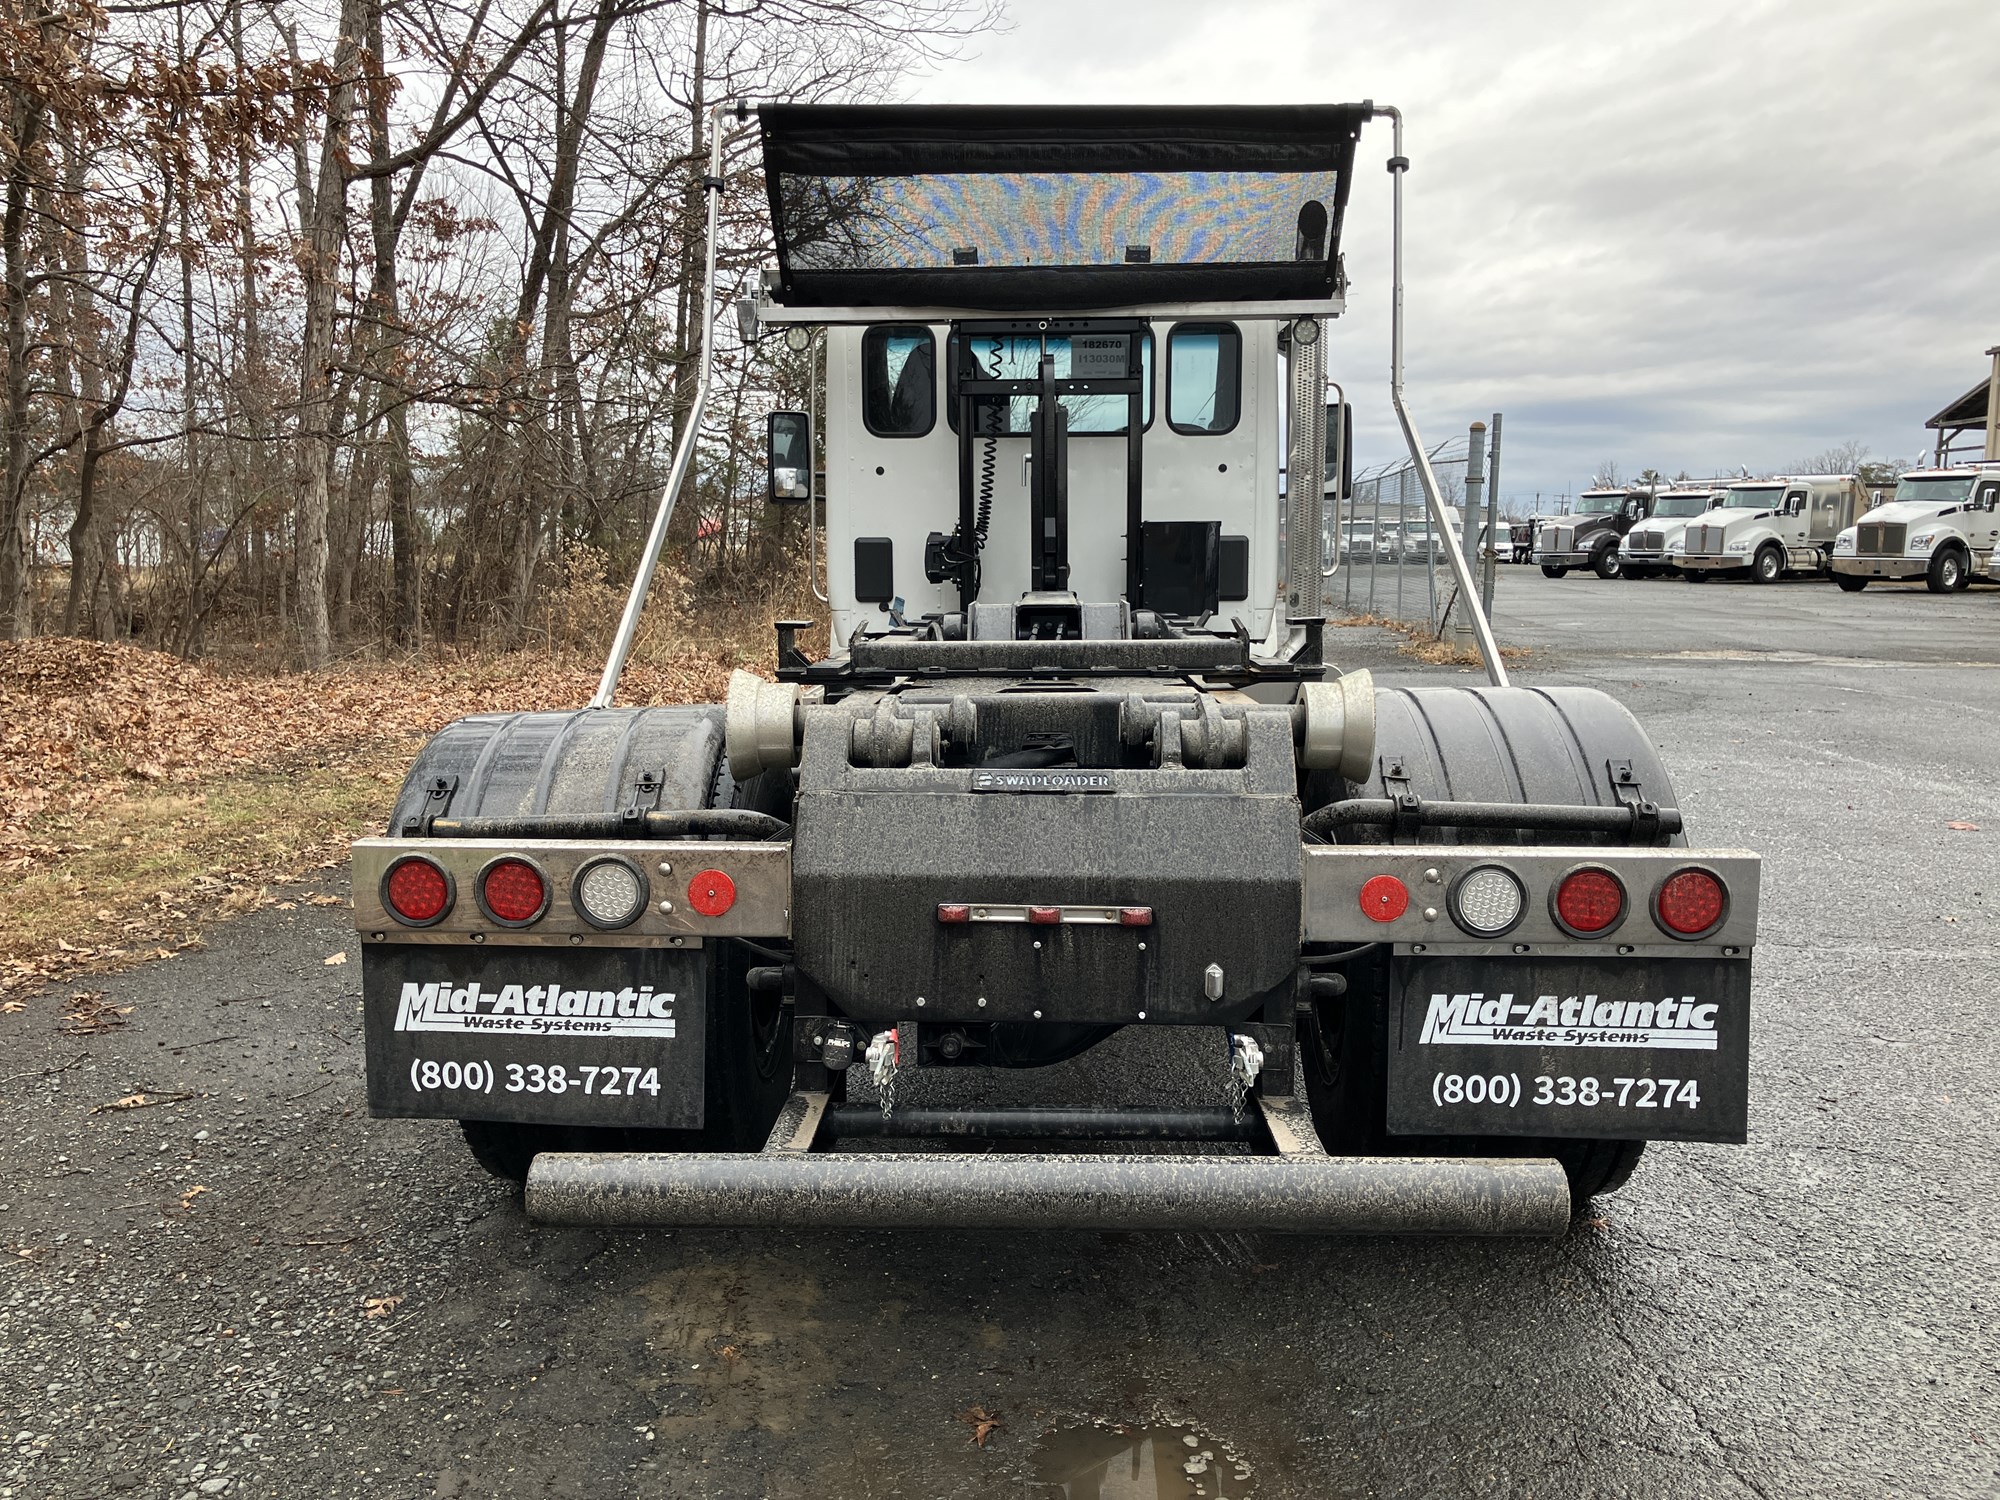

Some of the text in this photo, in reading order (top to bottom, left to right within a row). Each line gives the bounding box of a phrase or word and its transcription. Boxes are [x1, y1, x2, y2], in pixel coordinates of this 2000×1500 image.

[1082, 340, 1122, 349] 182670
[995, 774, 1109, 786] SWAPLOADER
[394, 982, 676, 1031] Mid-Atlantic
[1419, 993, 1719, 1044] Mid-Atlantic
[463, 1016, 612, 1033] Waste Systems
[1491, 1028, 1650, 1045] Waste Systems
[410, 1058, 662, 1096] (800) 338-7274
[1432, 1072, 1701, 1110] (800) 338-7274
